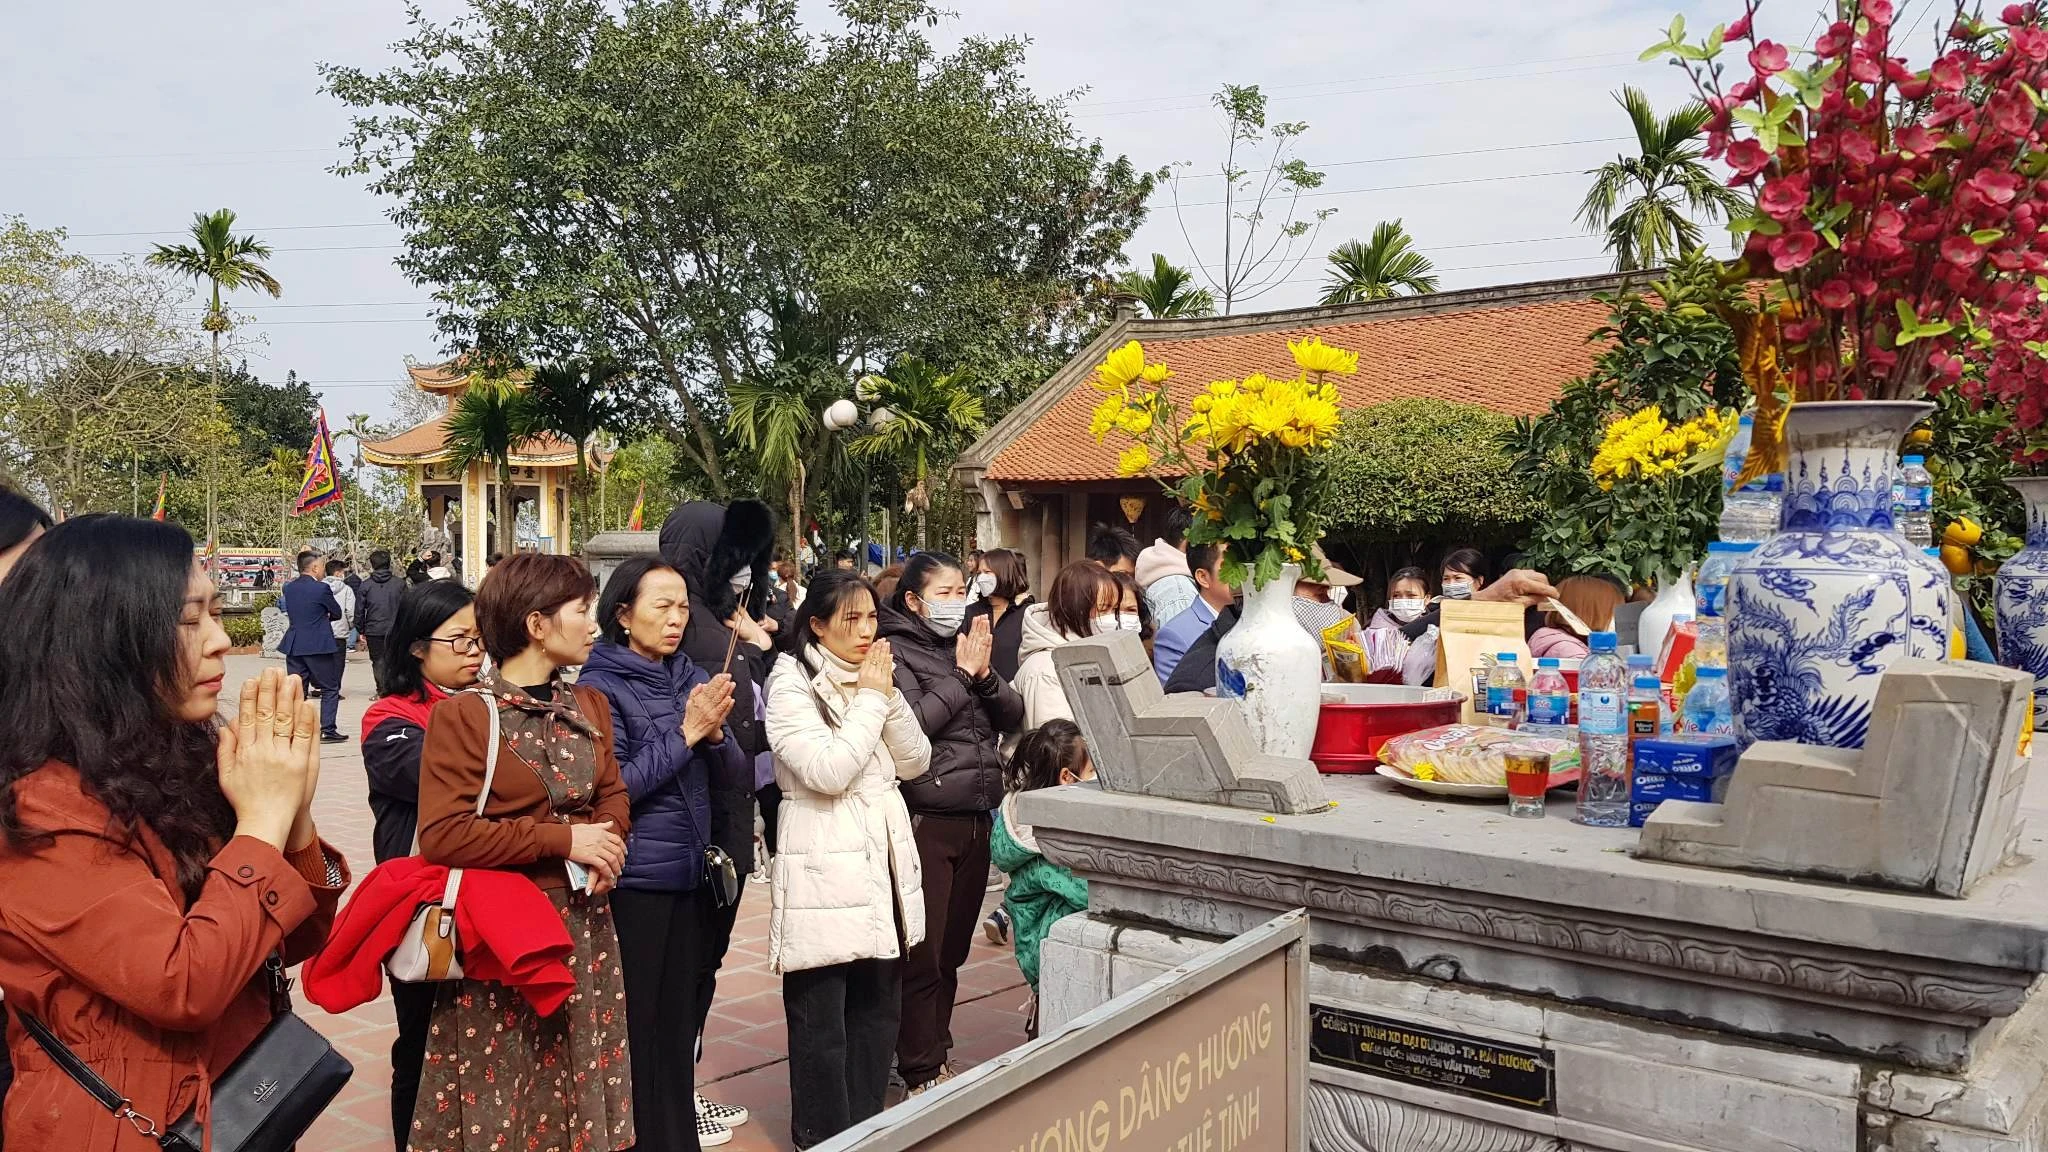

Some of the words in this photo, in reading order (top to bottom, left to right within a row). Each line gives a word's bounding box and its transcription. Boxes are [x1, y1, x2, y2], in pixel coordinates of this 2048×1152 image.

[1119, 1052, 1192, 1141] DÂNG
[1198, 1003, 1272, 1090] HƯƠNG
[1218, 1085, 1260, 1152] TĨNH
